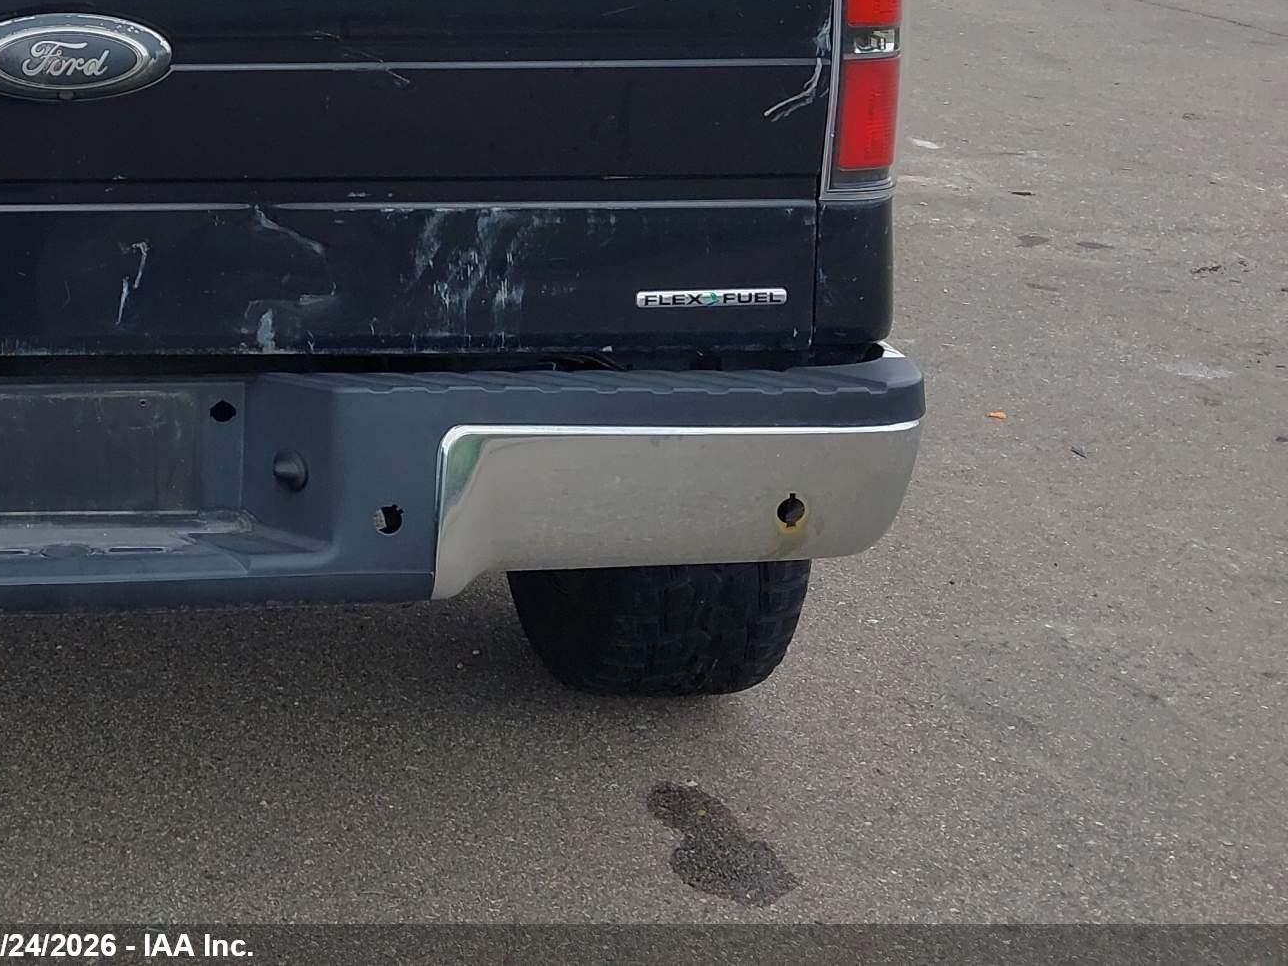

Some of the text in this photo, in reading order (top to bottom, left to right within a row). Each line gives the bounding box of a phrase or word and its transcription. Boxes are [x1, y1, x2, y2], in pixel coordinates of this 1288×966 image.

[21, 40, 110, 77] Ford
[643, 291, 782, 307] FLEX FUEL
